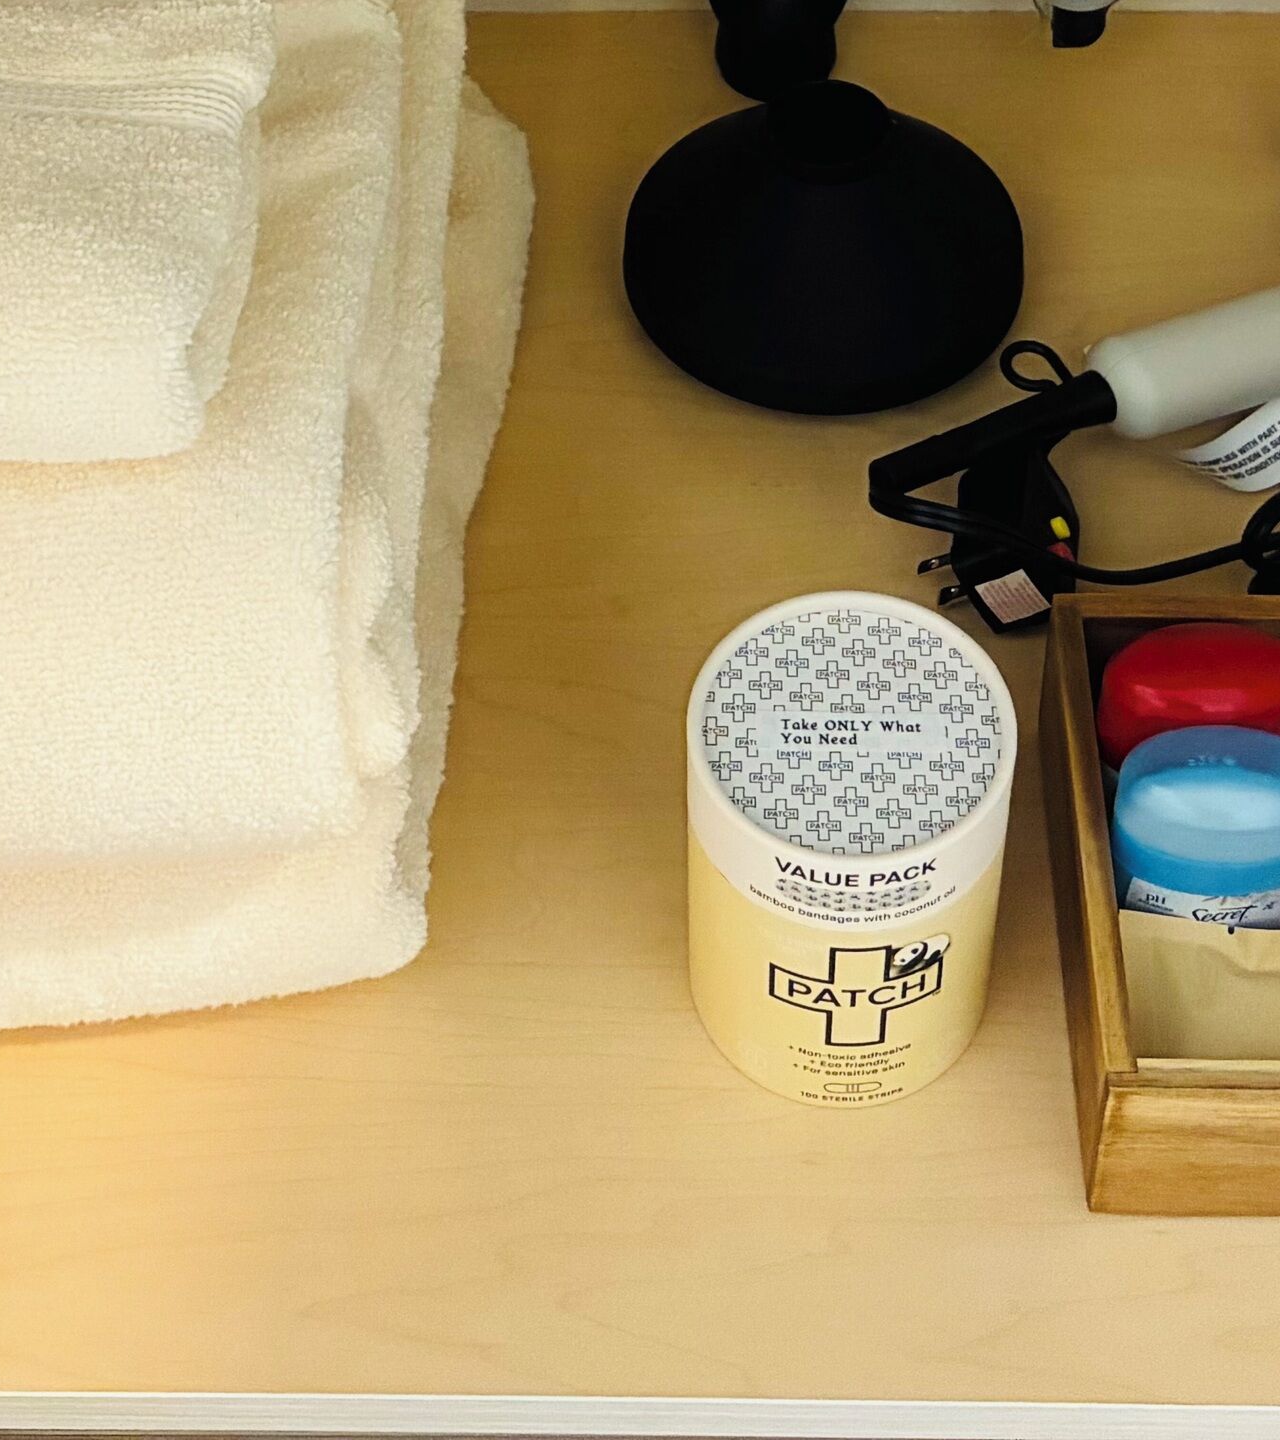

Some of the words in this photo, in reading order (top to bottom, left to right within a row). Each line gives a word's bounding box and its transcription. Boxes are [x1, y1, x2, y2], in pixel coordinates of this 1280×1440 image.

[1238, 441, 1259, 457] WITH
[1258, 424, 1279, 443] PART
[1261, 445, 1272, 456] IS
[781, 719, 818, 730] Take
[824, 720, 872, 731] ONLY
[880, 721, 921, 733] What
[781, 733, 812, 745] You
[819, 734, 858, 745] Need
[774, 856, 860, 887] VALUE
[869, 857, 937, 887] PACK
[749, 884, 795, 912] bamboo
[798, 908, 860, 924] bandages
[864, 913, 891, 923] with
[894, 896, 941, 918] coconut
[943, 885, 956, 898] oil
[1192, 904, 1258, 923] Secret
[788, 973, 926, 1007] PATCH
[798, 1047, 856, 1061] Non-toxic
[860, 1043, 912, 1060] adhesive
[803, 1065, 821, 1074] For
[824, 1067, 879, 1076] sensitive
[881, 1061, 906, 1072] skin
[820, 1060, 842, 1068] Eco
[845, 1058, 890, 1069] friendly
[822, 1094, 864, 1102] STERILE
